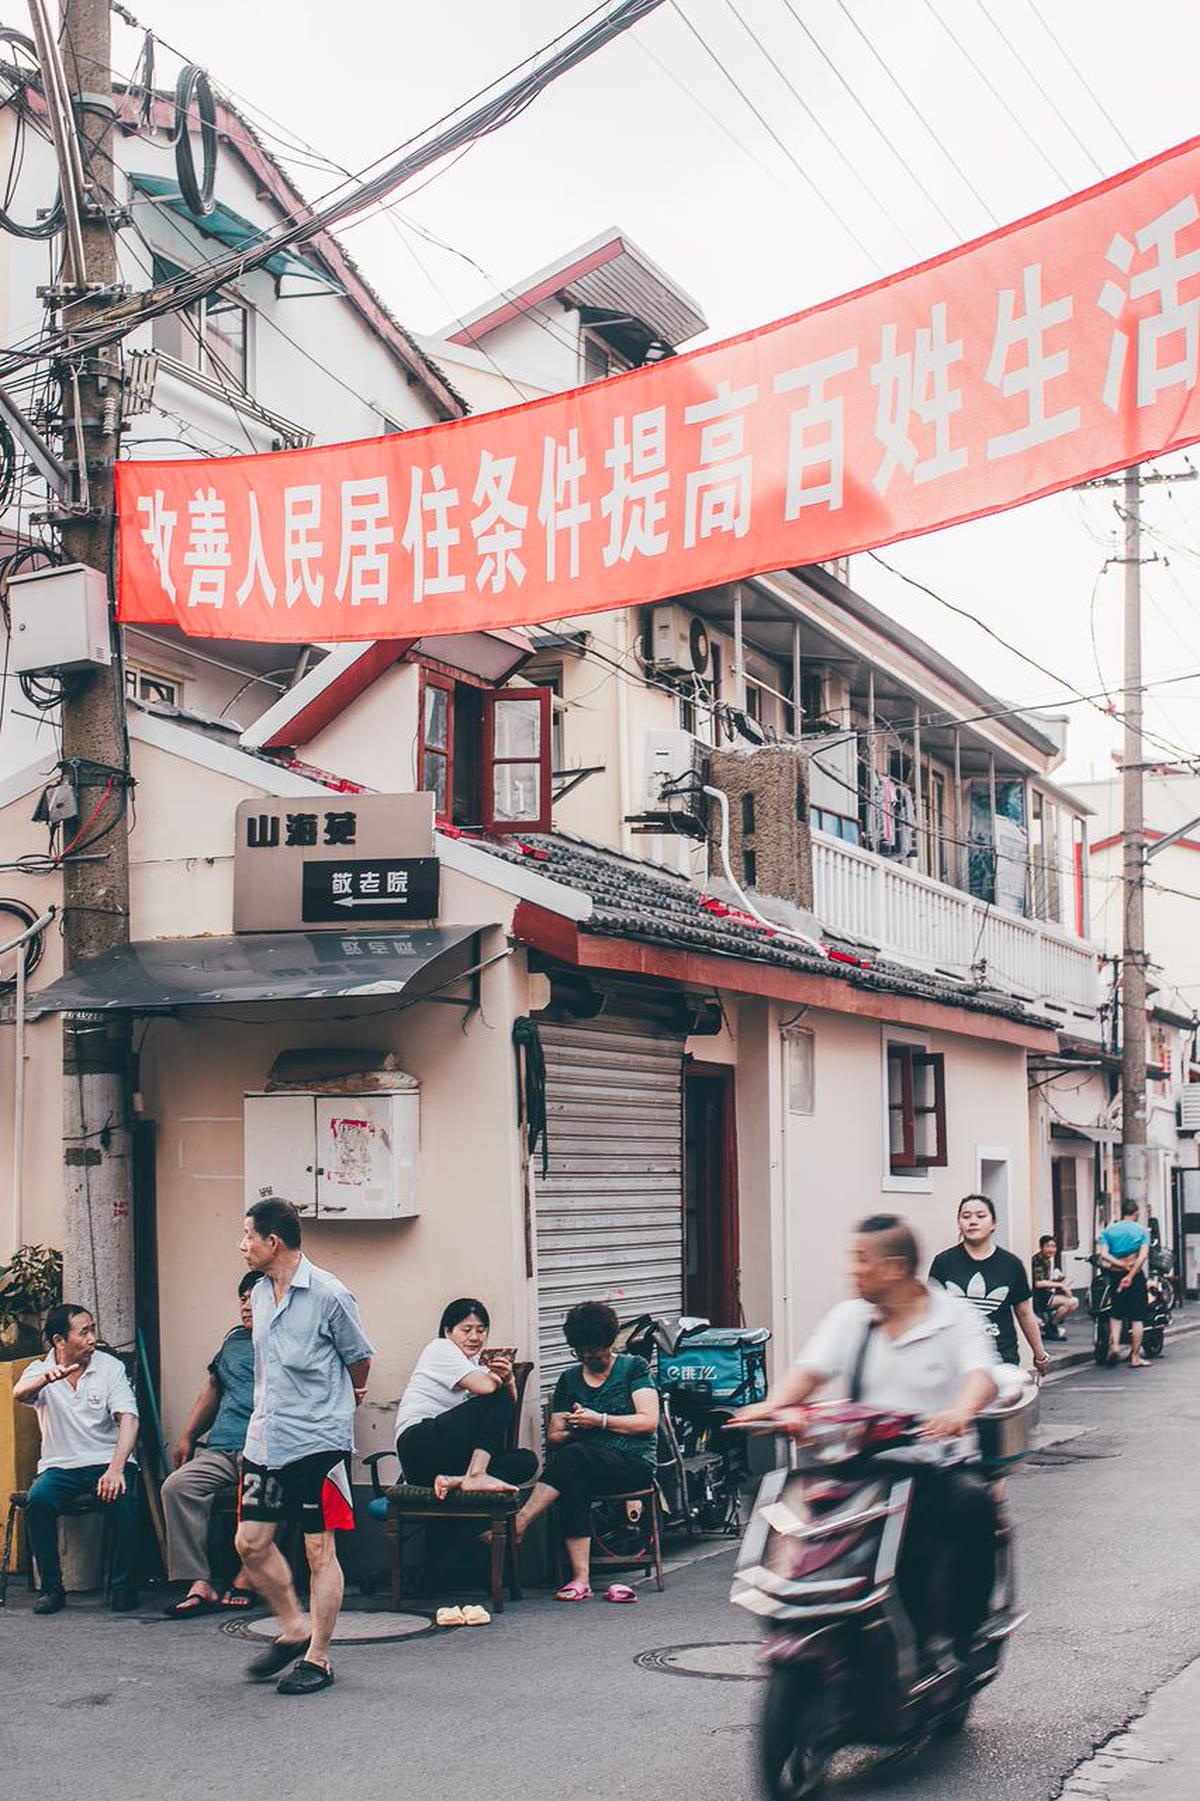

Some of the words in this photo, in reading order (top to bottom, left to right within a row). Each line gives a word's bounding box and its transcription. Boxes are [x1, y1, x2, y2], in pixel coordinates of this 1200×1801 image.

[136, 194, 1200, 609] 改善人民居住条件提高百姓生活
[332, 871, 408, 894] 敬老院
